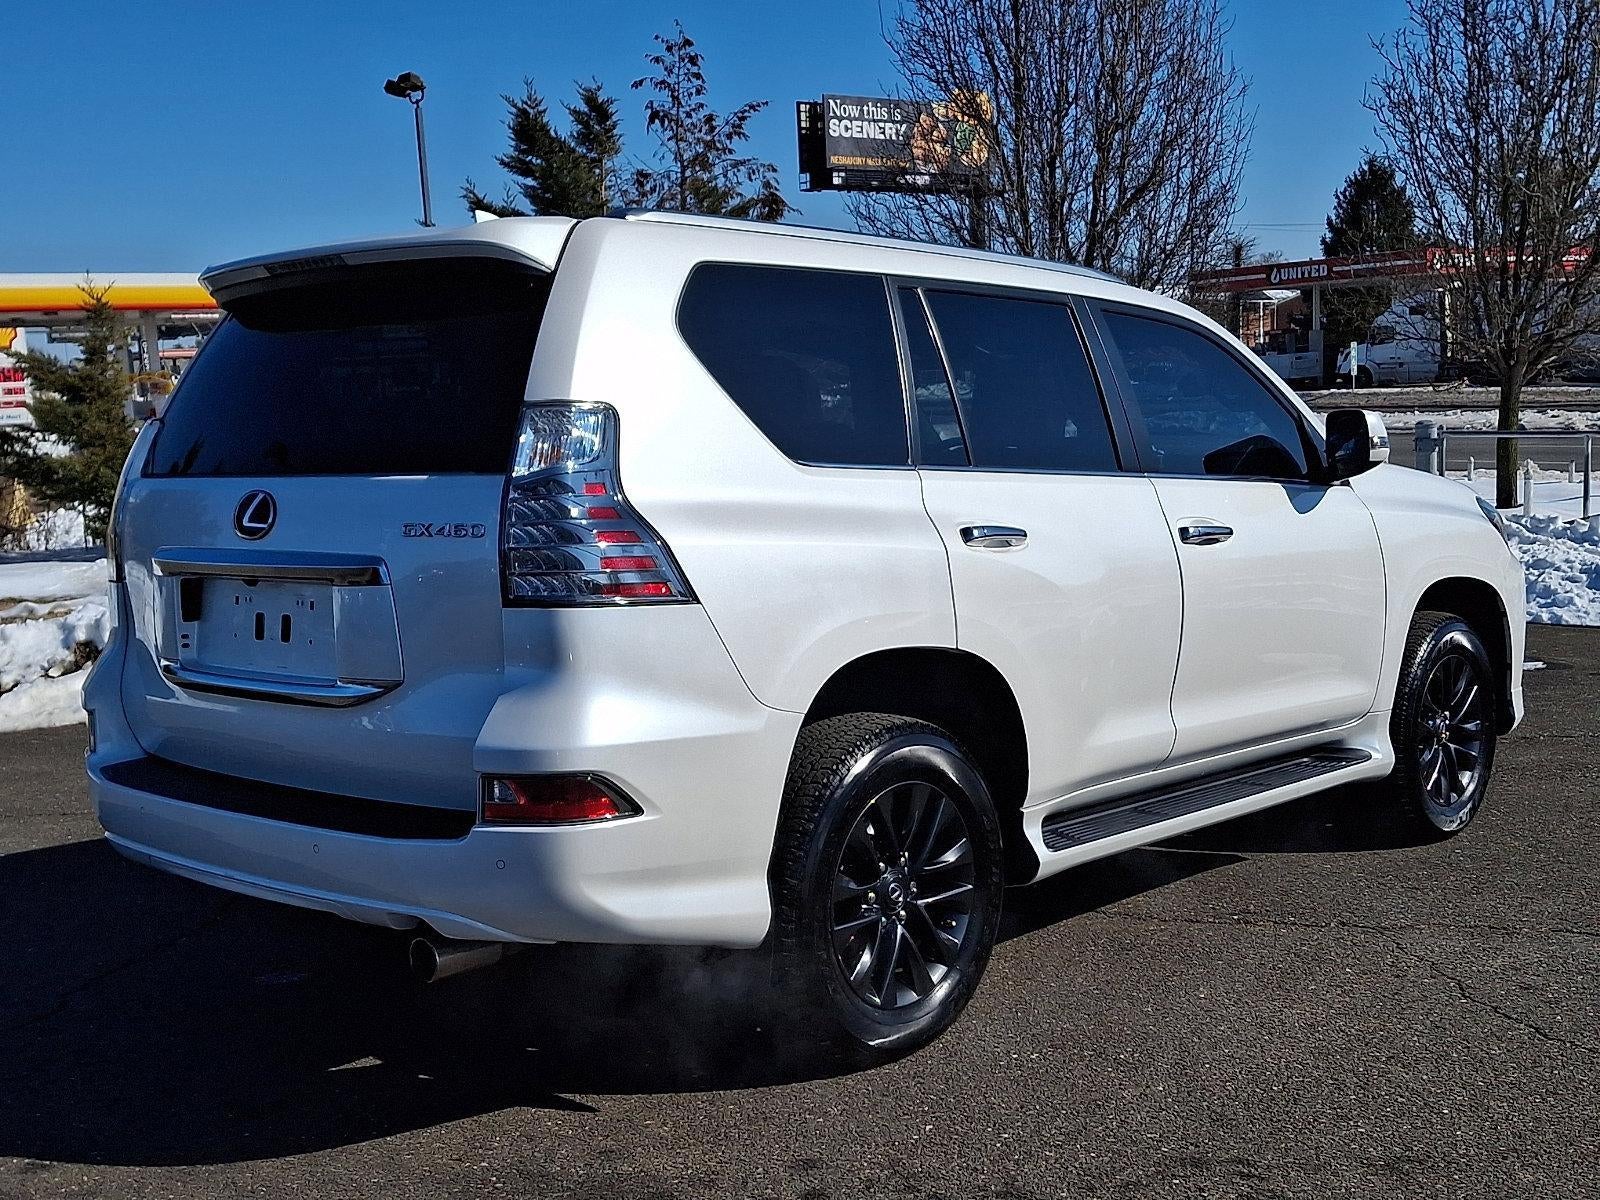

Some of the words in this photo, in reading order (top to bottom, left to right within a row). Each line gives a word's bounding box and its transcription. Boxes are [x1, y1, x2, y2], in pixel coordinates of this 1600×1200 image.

[828, 99, 860, 117] Now
[863, 102, 888, 120] this
[890, 104, 901, 121] is
[829, 119, 907, 140] SCENERY
[1281, 265, 1328, 280] UNITED
